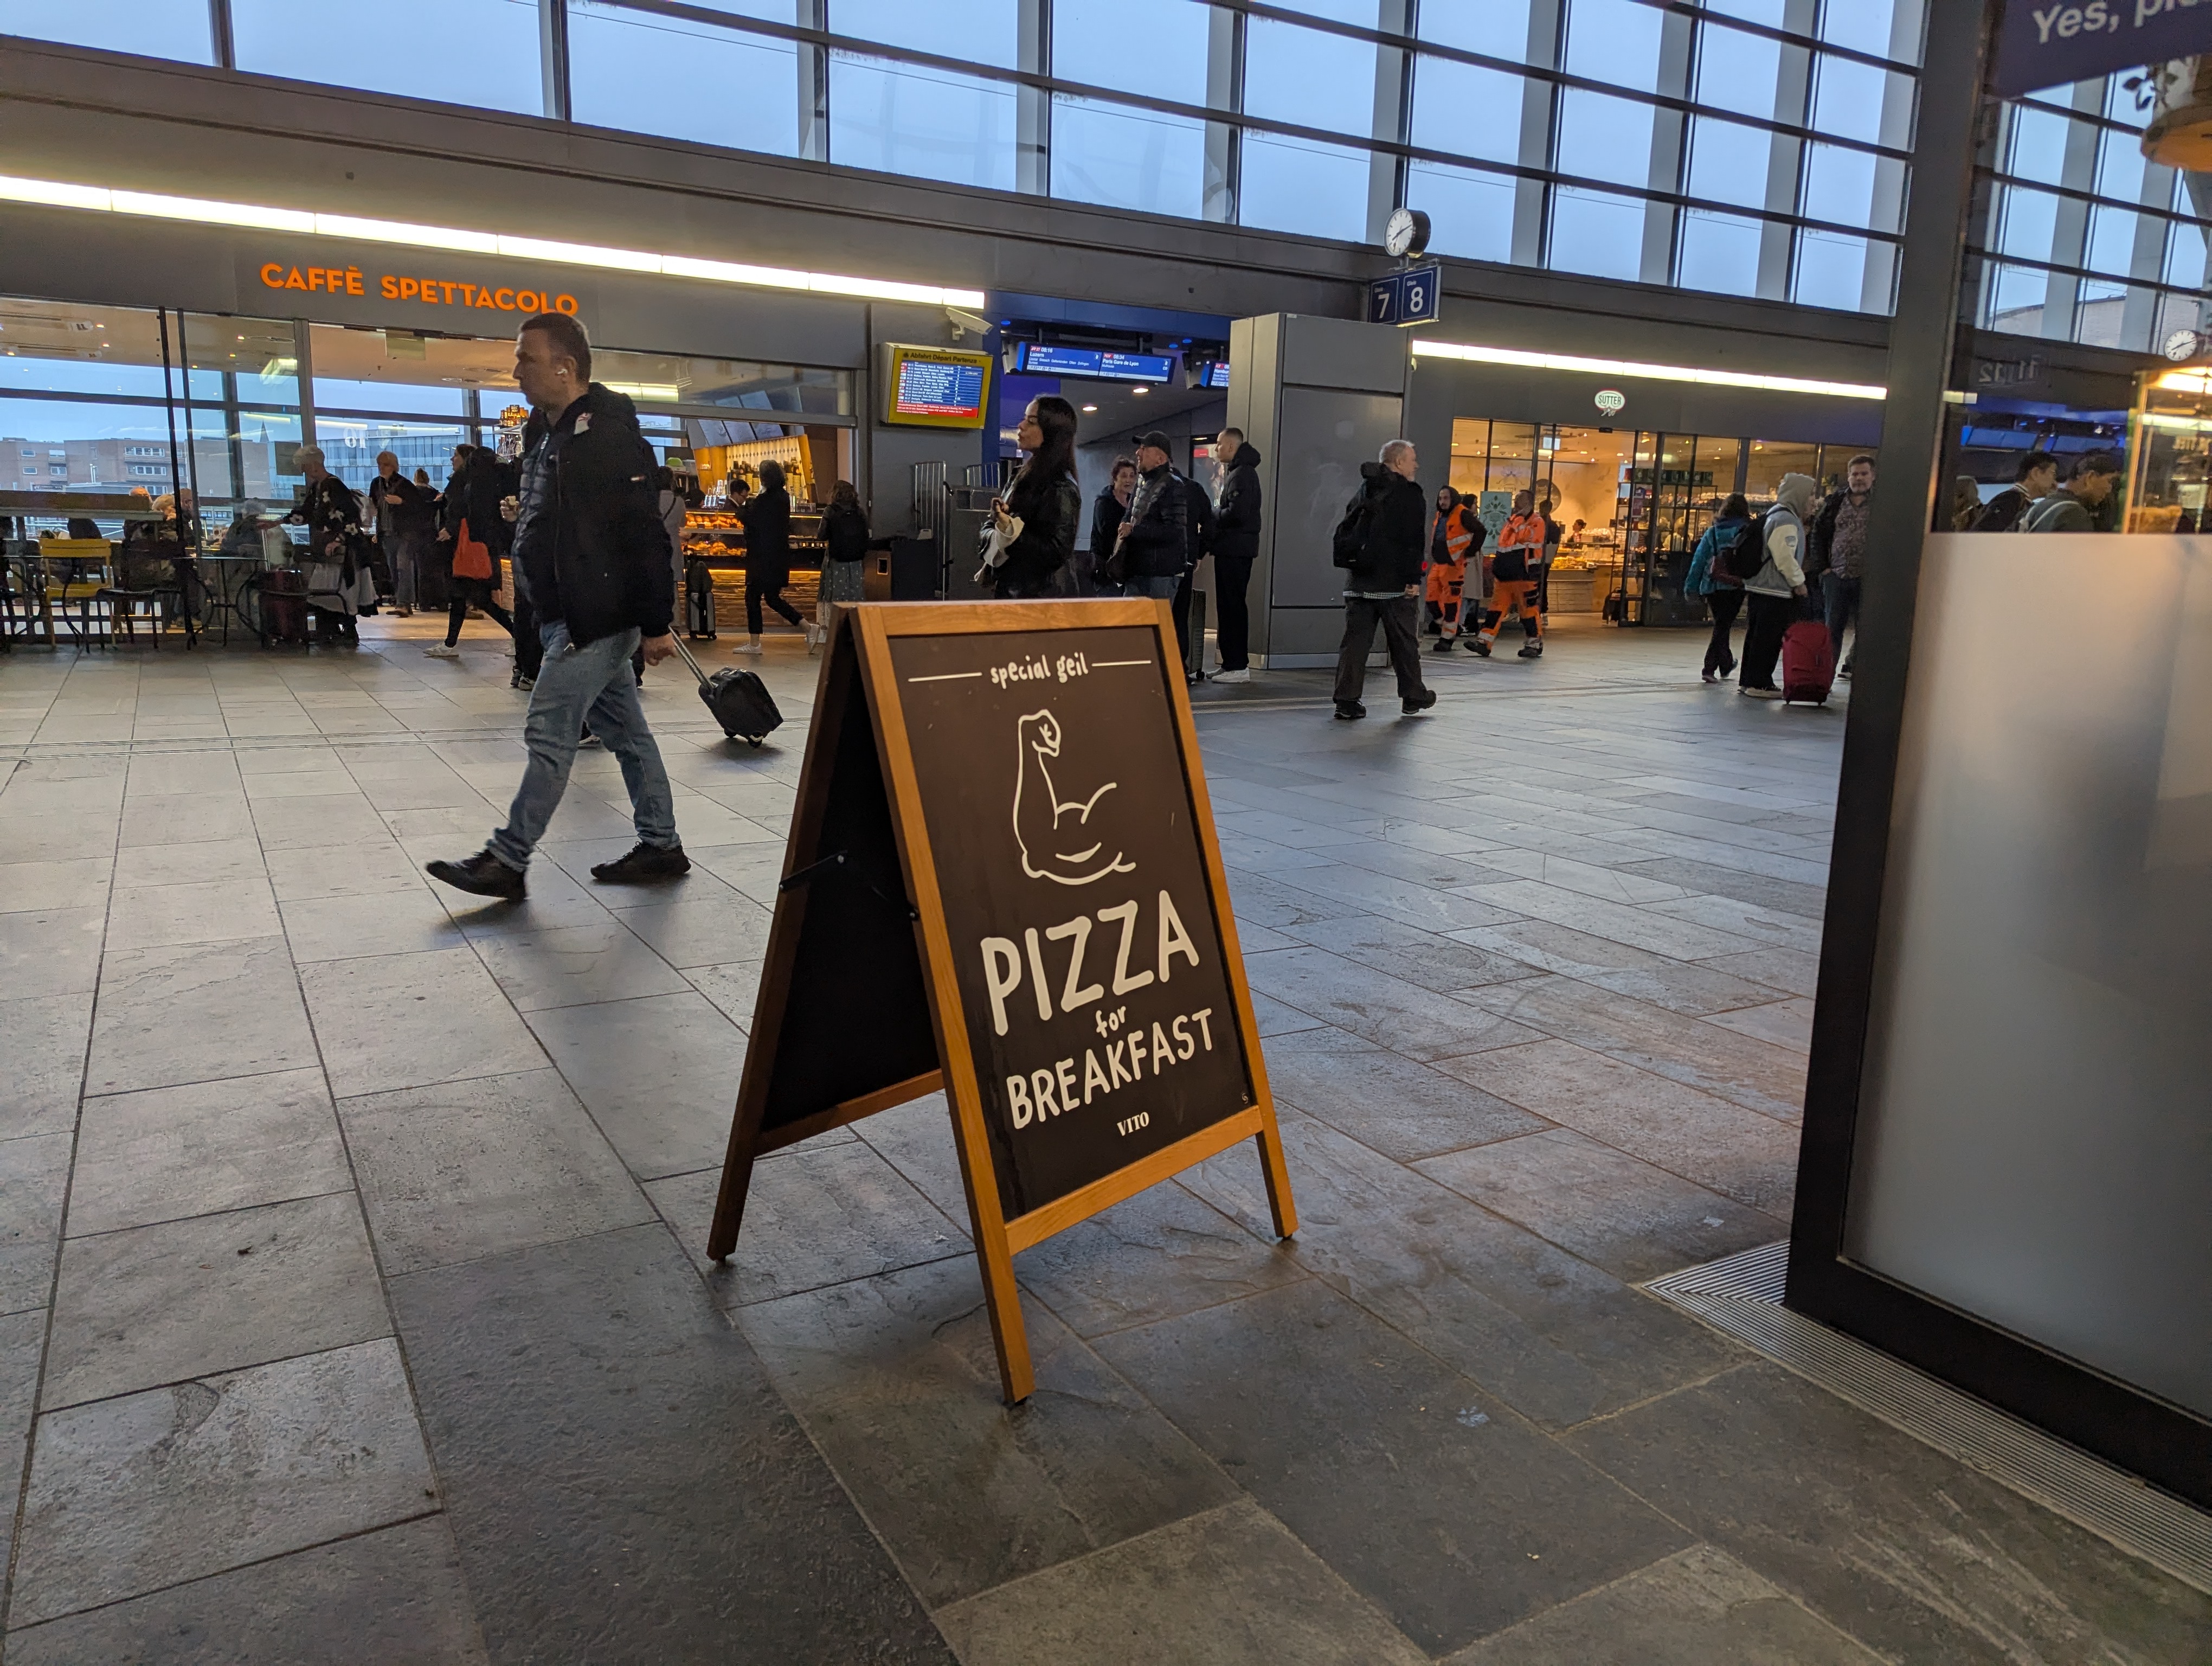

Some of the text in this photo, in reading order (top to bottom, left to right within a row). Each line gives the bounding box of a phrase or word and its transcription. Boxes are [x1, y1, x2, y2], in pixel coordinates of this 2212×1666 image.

[2033, 2, 2120, 44] Yes,
[261, 264, 578, 316] CAFFÈ SPETTACOLO
[1378, 293, 1390, 319] 7
[1410, 287, 1423, 313] 8
[933, 354, 951, 362] Départ
[1599, 395, 1621, 405] SUTTER
[991, 652, 1089, 689] special geil
[980, 889, 1199, 1036] PIZZA
[1096, 1006, 1126, 1038] for
[1006, 1008, 1212, 1129] BREAKFAST
[1116, 1111, 1150, 1136] VITO
